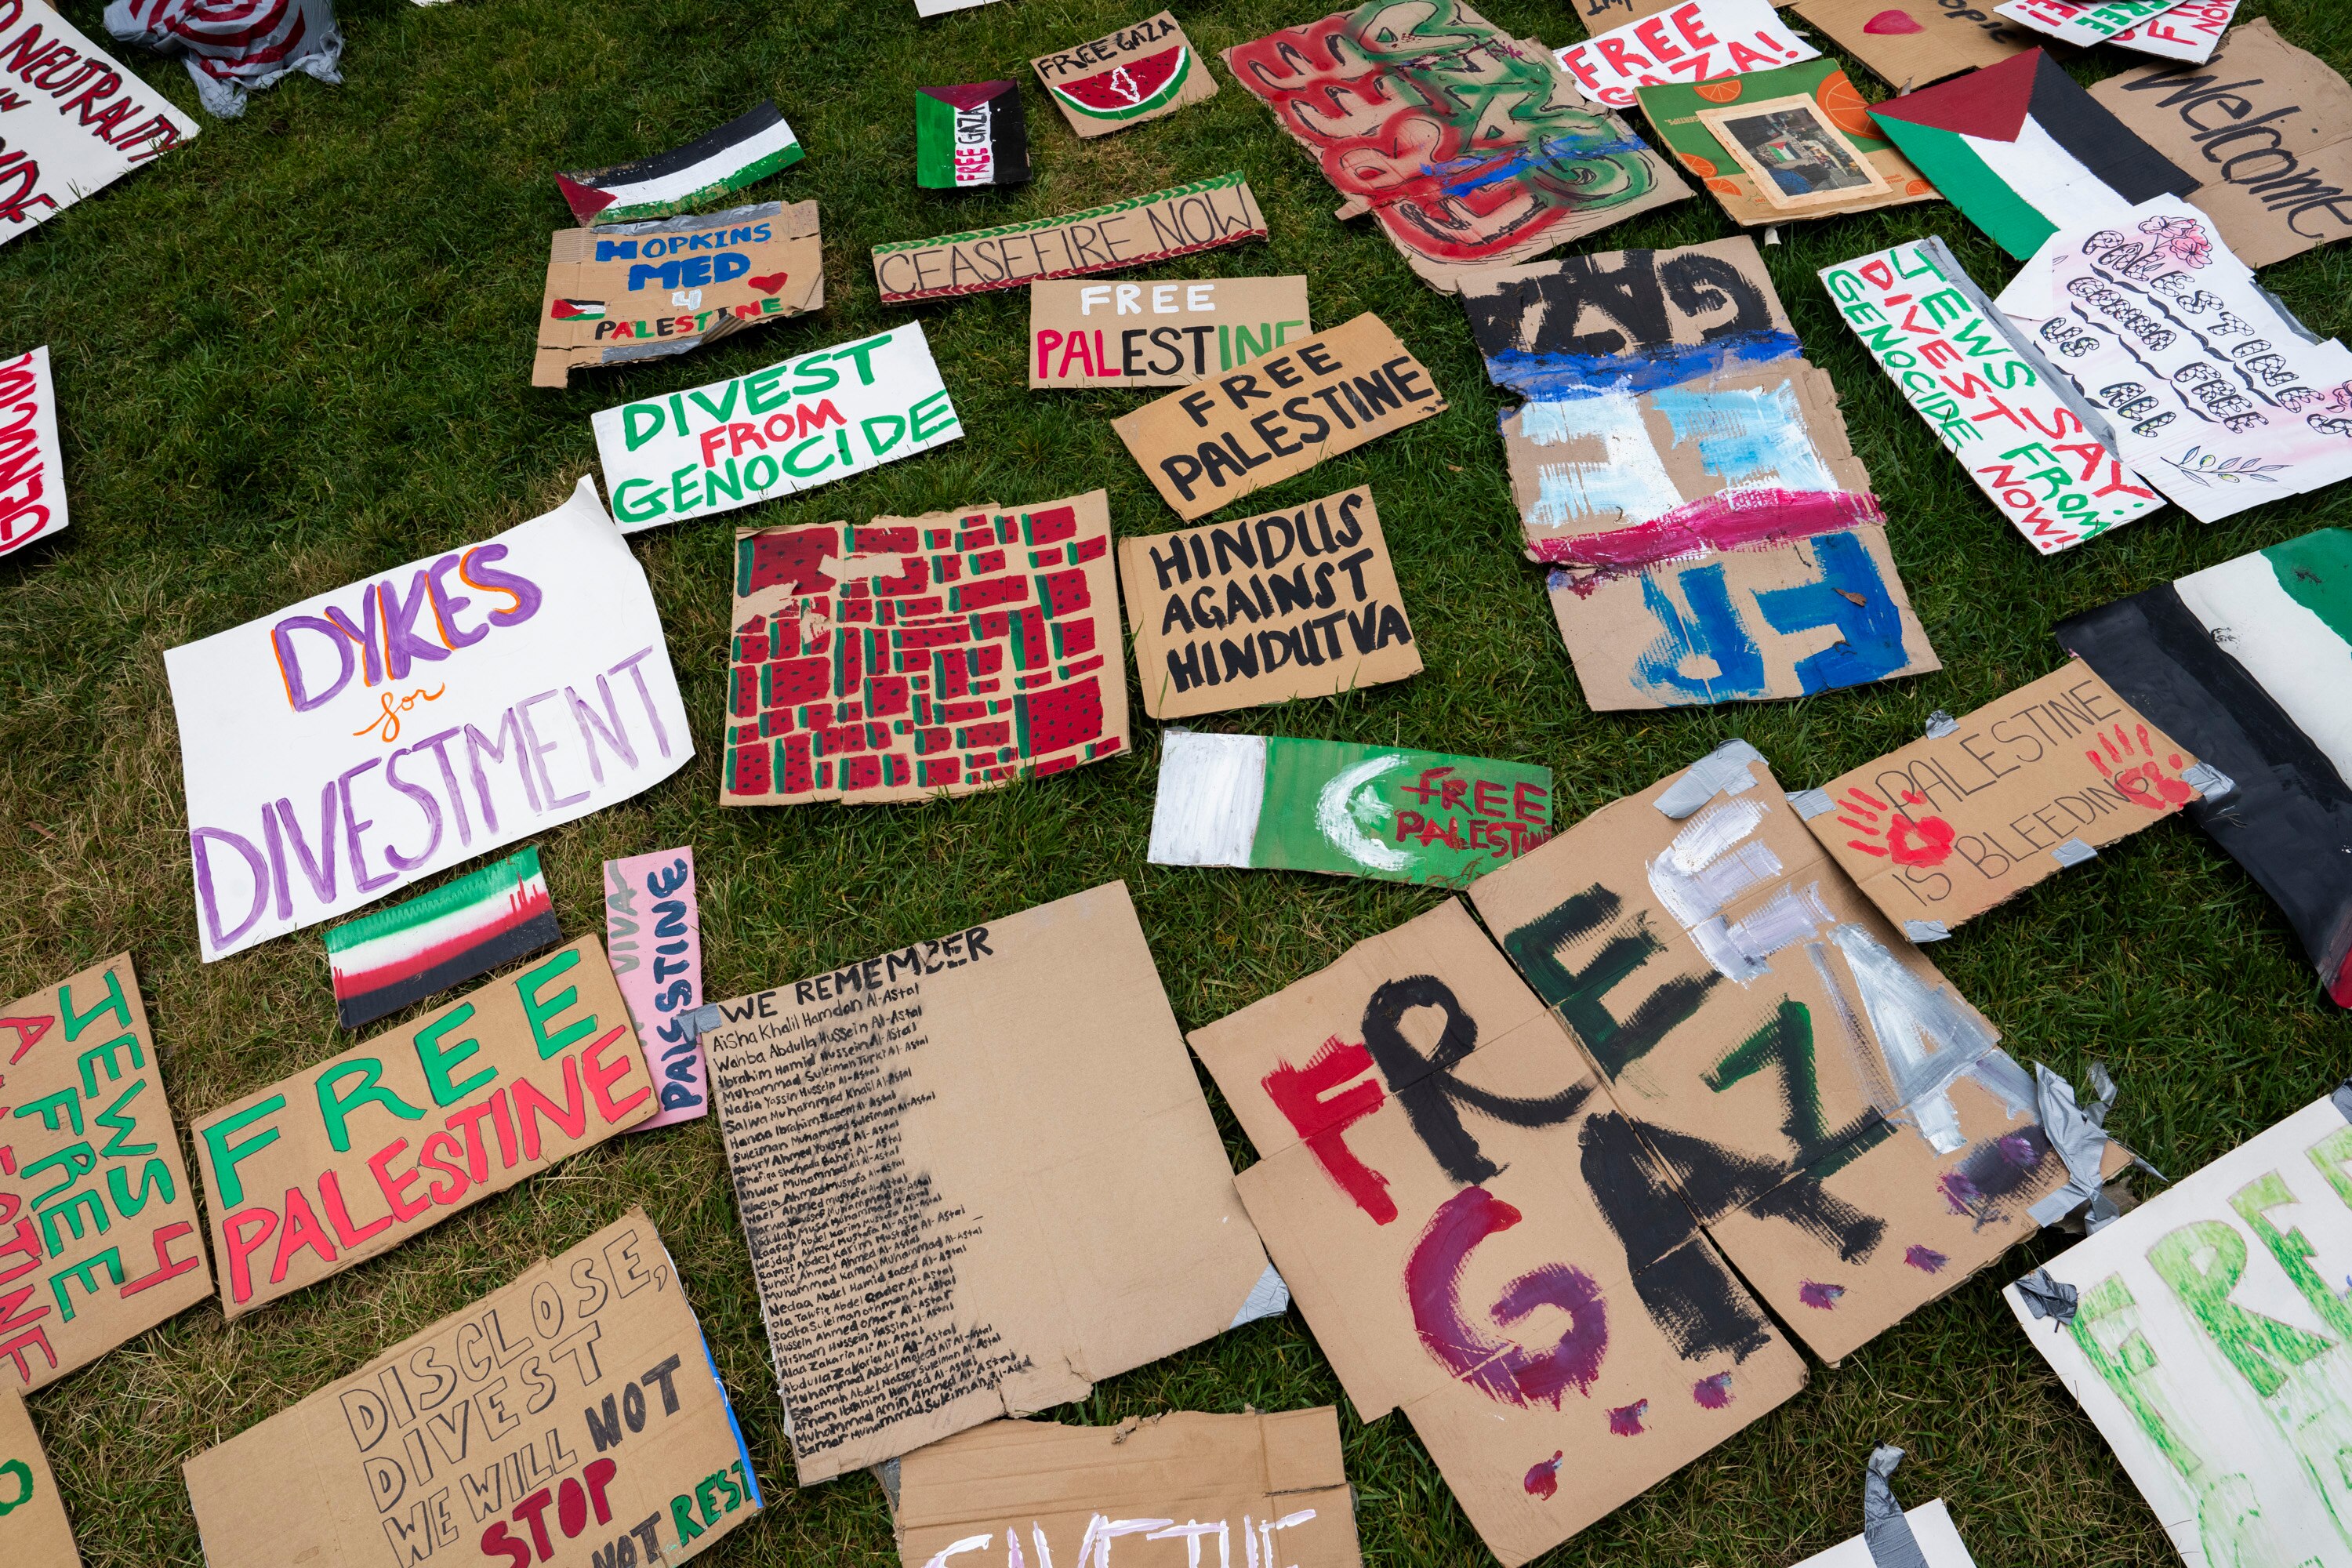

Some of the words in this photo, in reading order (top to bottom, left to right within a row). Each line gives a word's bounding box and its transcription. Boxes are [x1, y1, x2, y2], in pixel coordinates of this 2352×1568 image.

[0, 24, 190, 163] NEUTRALITY
[1038, 31, 1117, 80] FREE
[1116, 18, 1174, 62] GAZA
[1562, 2, 1720, 90] FREE
[953, 147, 989, 182] FREE
[956, 106, 986, 144] GAZA
[2121, 53, 2352, 241] Welcome
[595, 223, 771, 262] HOPKINS
[628, 252, 750, 291] MED
[879, 220, 1130, 295] CEASEFIRE
[1145, 185, 1254, 253] NOW
[671, 289, 702, 311] 4
[1081, 283, 1215, 315] FREE
[1889, 249, 2037, 390] JEWS
[2067, 277, 2176, 351] GONNA
[2174, 361, 2269, 434] FREE
[623, 335, 892, 452] DIVEST
[700, 399, 848, 467] FROM
[1160, 355, 1435, 502] PALESTINE
[1178, 342, 1341, 428] FREE
[1828, 270, 1984, 448] GENOCIDE
[1976, 465, 2078, 548] NOW!
[1859, 260, 2027, 432] DIVEST
[1998, 441, 2111, 540] FROM
[2040, 317, 2099, 357] US
[2100, 382, 2176, 437] ALL
[612, 390, 958, 524] GENOCIDE
[1149, 493, 1363, 591] HINDUS
[1162, 547, 1374, 635] AGAINST
[272, 543, 543, 712] DYKES
[1167, 599, 1412, 693] HINDUTVA
[353, 683, 445, 742] for
[1875, 680, 2122, 825] PALESTINE
[190, 645, 670, 951] DIVESTMENT
[1401, 767, 1548, 825] FREE
[1892, 869, 1951, 906] IS
[1955, 771, 2150, 879] BLEEDING
[607, 860, 640, 976] VIVA
[719, 991, 778, 1023] WE
[758, 1014, 800, 1040] Khalil
[1261, 797, 1835, 1225] FREE
[58, 971, 176, 1218] JEWS
[121, 1221, 199, 1299] 4
[201, 949, 599, 1210] FREE
[13, 1087, 125, 1324] FREE
[223, 1025, 652, 1305] PALESTINE
[339, 1229, 668, 1453] DISCLOSE,
[364, 1319, 604, 1513] DIVEST
[382, 1486, 459, 1568] WE
[459, 1428, 579, 1523] WILL
[584, 1353, 681, 1453] NOT
[480, 1457, 618, 1568] STOP
[591, 1510, 662, 1568] NOT
